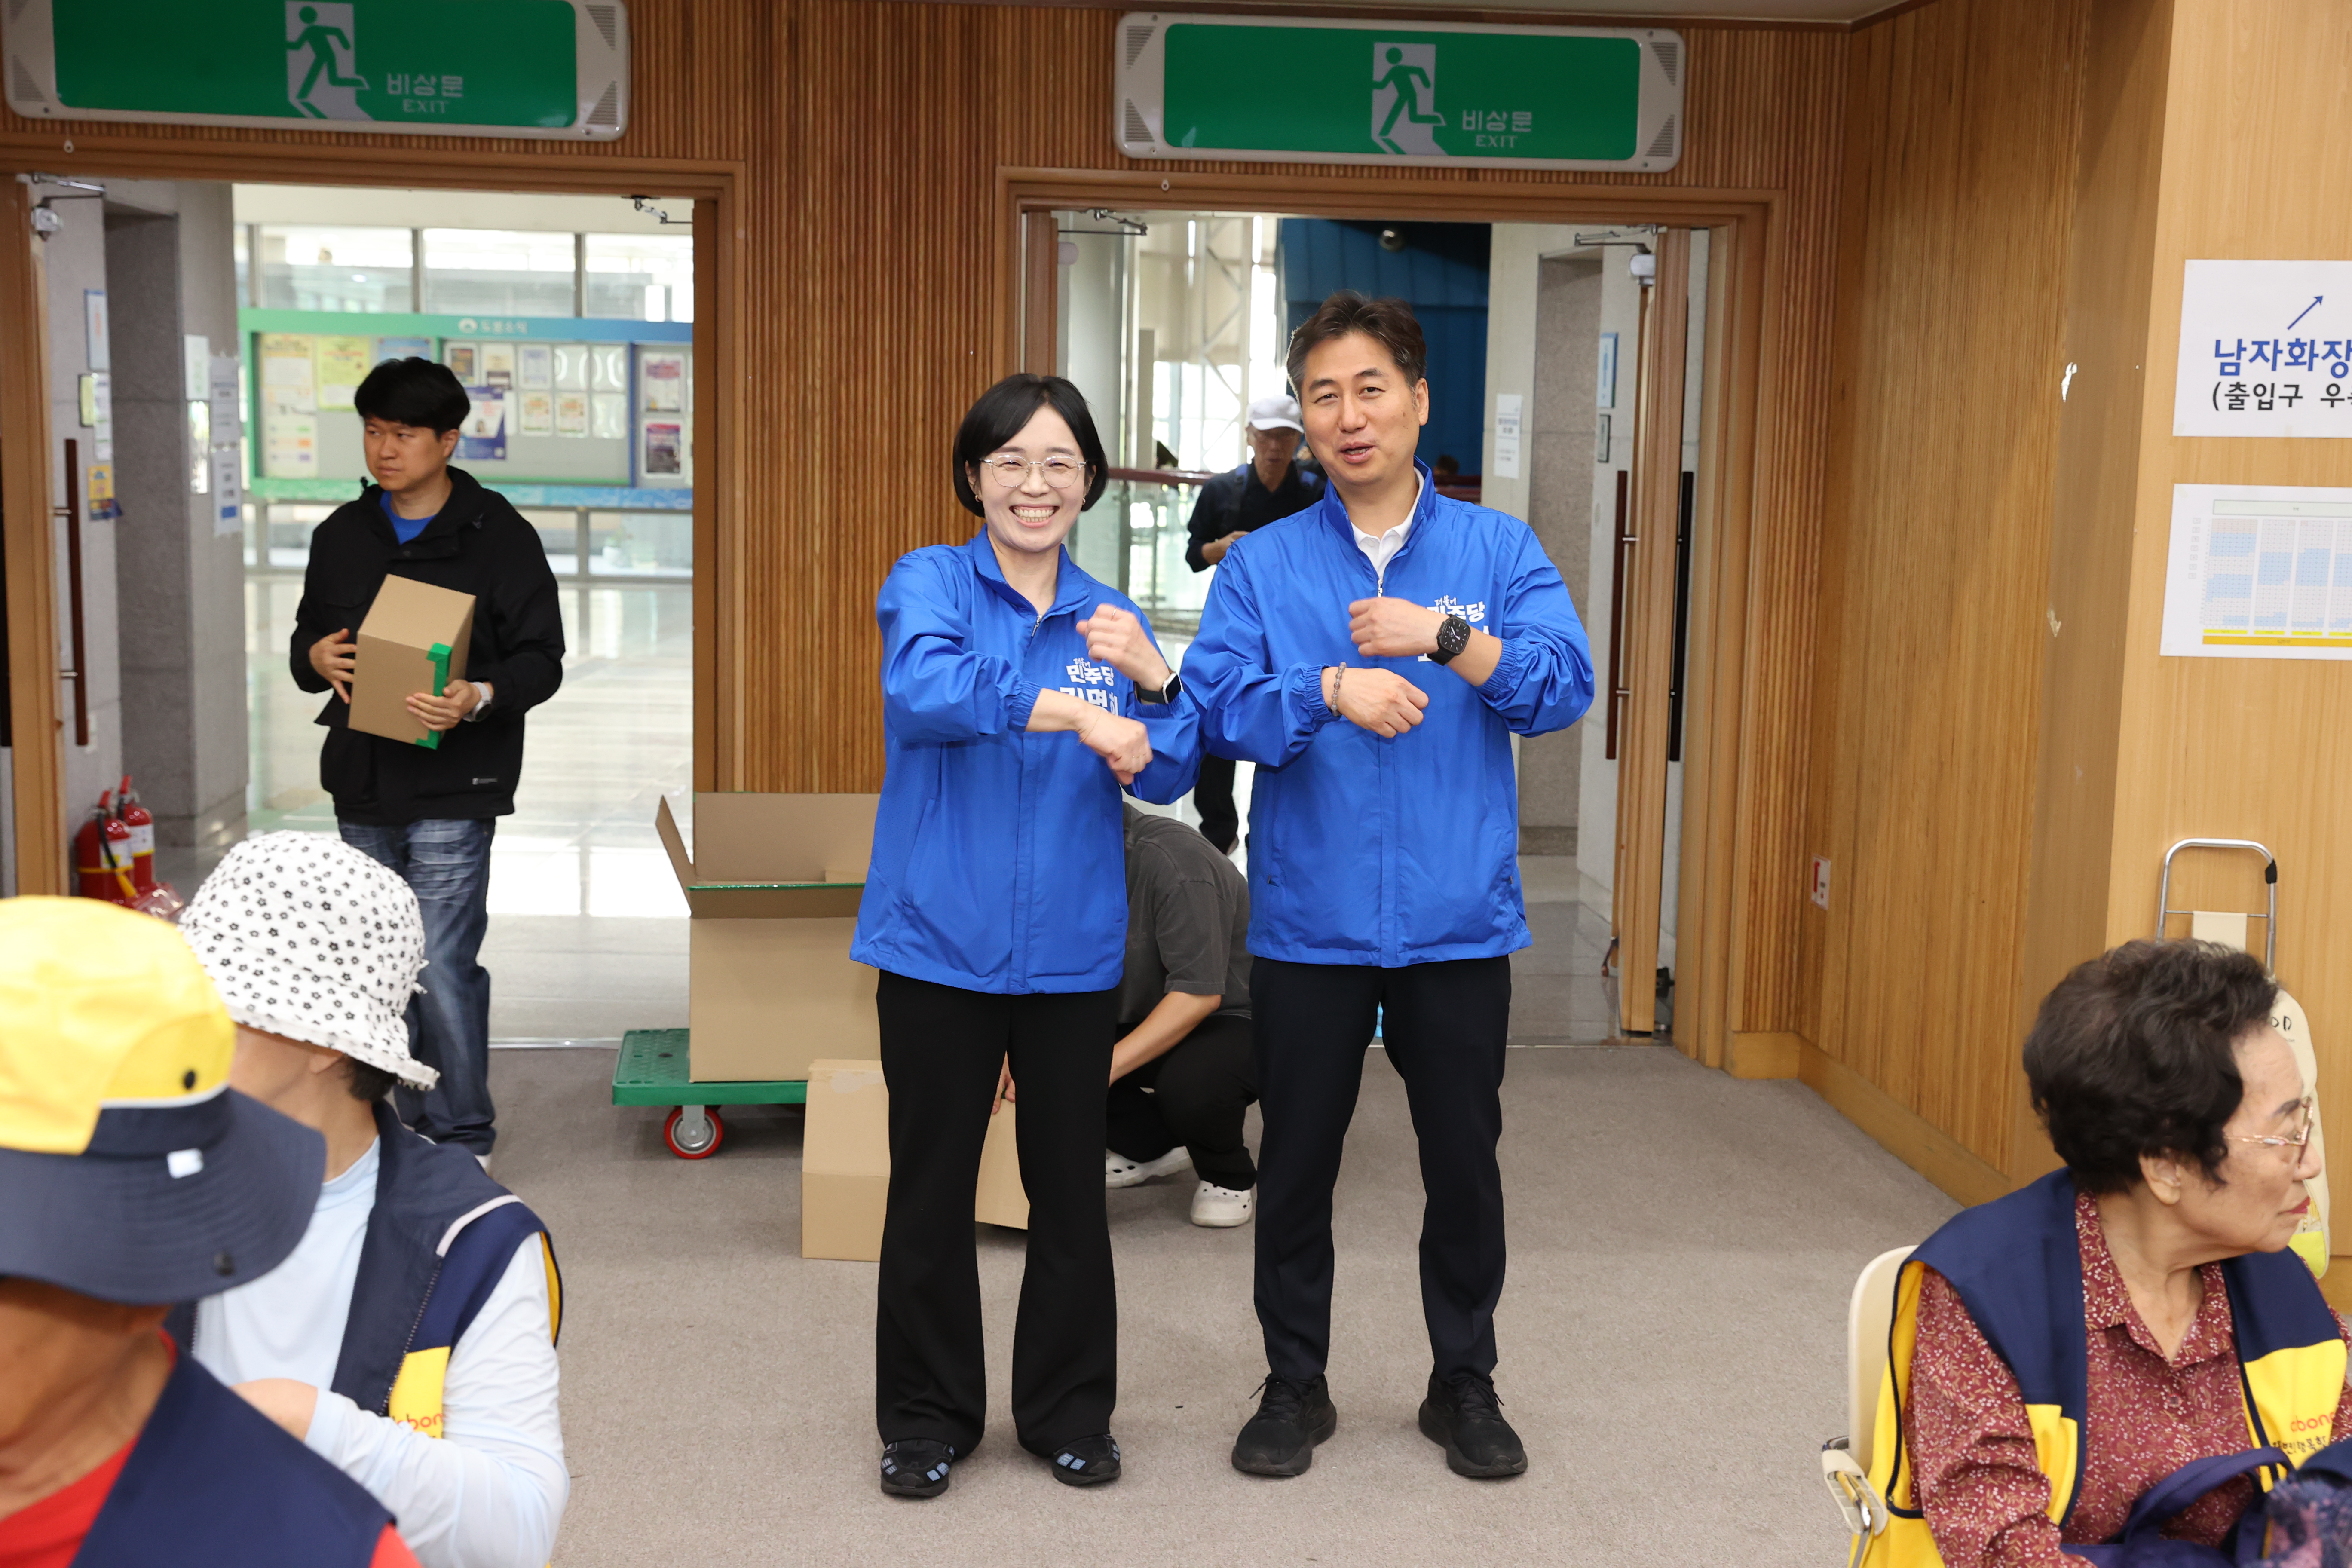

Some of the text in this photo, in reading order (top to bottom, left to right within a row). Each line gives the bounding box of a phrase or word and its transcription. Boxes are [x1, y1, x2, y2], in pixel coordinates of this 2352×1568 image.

[388, 74, 463, 97] 비상문
[403, 98, 450, 114] EXIT
[1463, 110, 1532, 132] 비상문
[1476, 135, 1518, 148] EXIT
[2214, 338, 2352, 379] 남자화장
[2213, 381, 2303, 411] (출입구
[1434, 594, 1457, 607] 더불어
[1066, 665, 1114, 687] 민주당
